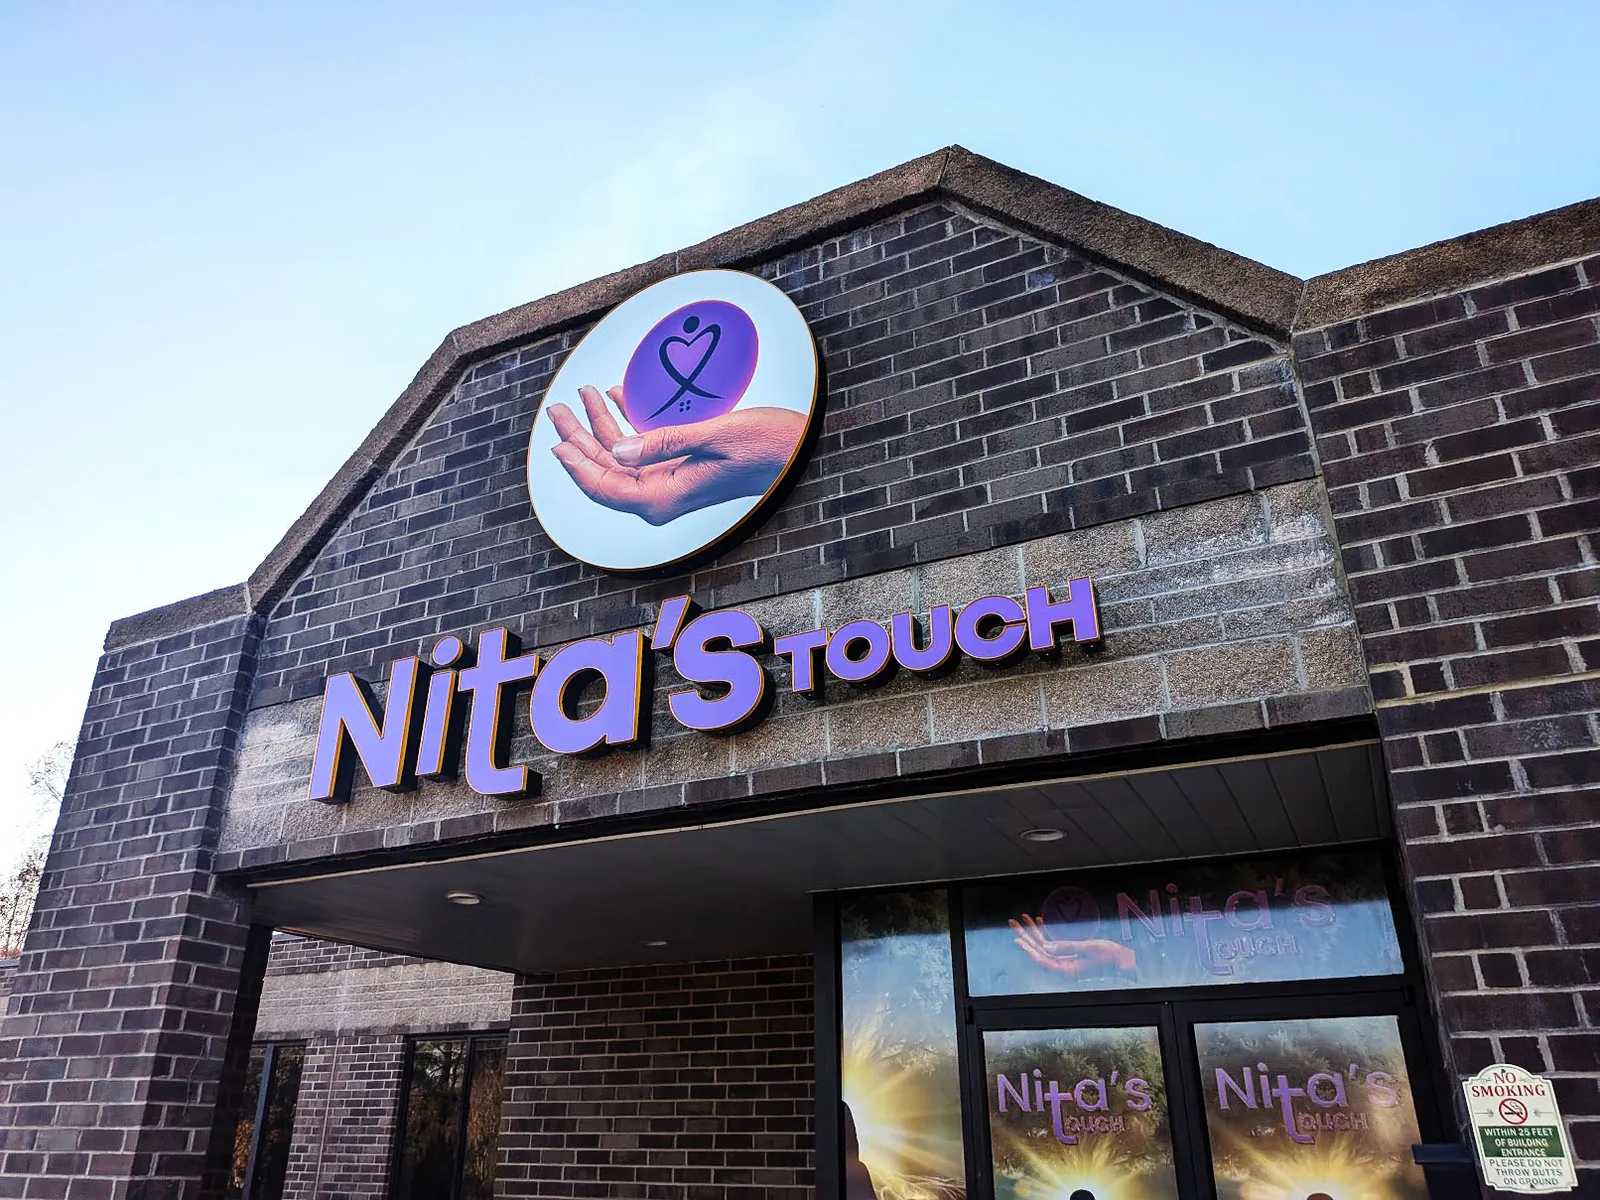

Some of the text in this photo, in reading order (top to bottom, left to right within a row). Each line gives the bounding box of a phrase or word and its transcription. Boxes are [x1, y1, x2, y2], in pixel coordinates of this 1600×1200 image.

[308, 577, 1100, 800] Nita's TOUCH
[1116, 877, 1336, 975] Nita's
[1493, 1071, 1517, 1084] NO
[1471, 1084, 1546, 1098] SMOKING
[997, 1066, 1152, 1145] Nita's
[1215, 1062, 1399, 1144] Nita's
[1484, 1127, 1553, 1136] WITHIN 25 FEET
[1494, 1138, 1549, 1147] OF BUILDING
[1501, 1148, 1547, 1157] ENTRANCE
[1489, 1159, 1563, 1167] PLEASE DO NOT
[1496, 1168, 1563, 1176] THROW BUTTS
[1504, 1177, 1559, 1186] ON GROUND
